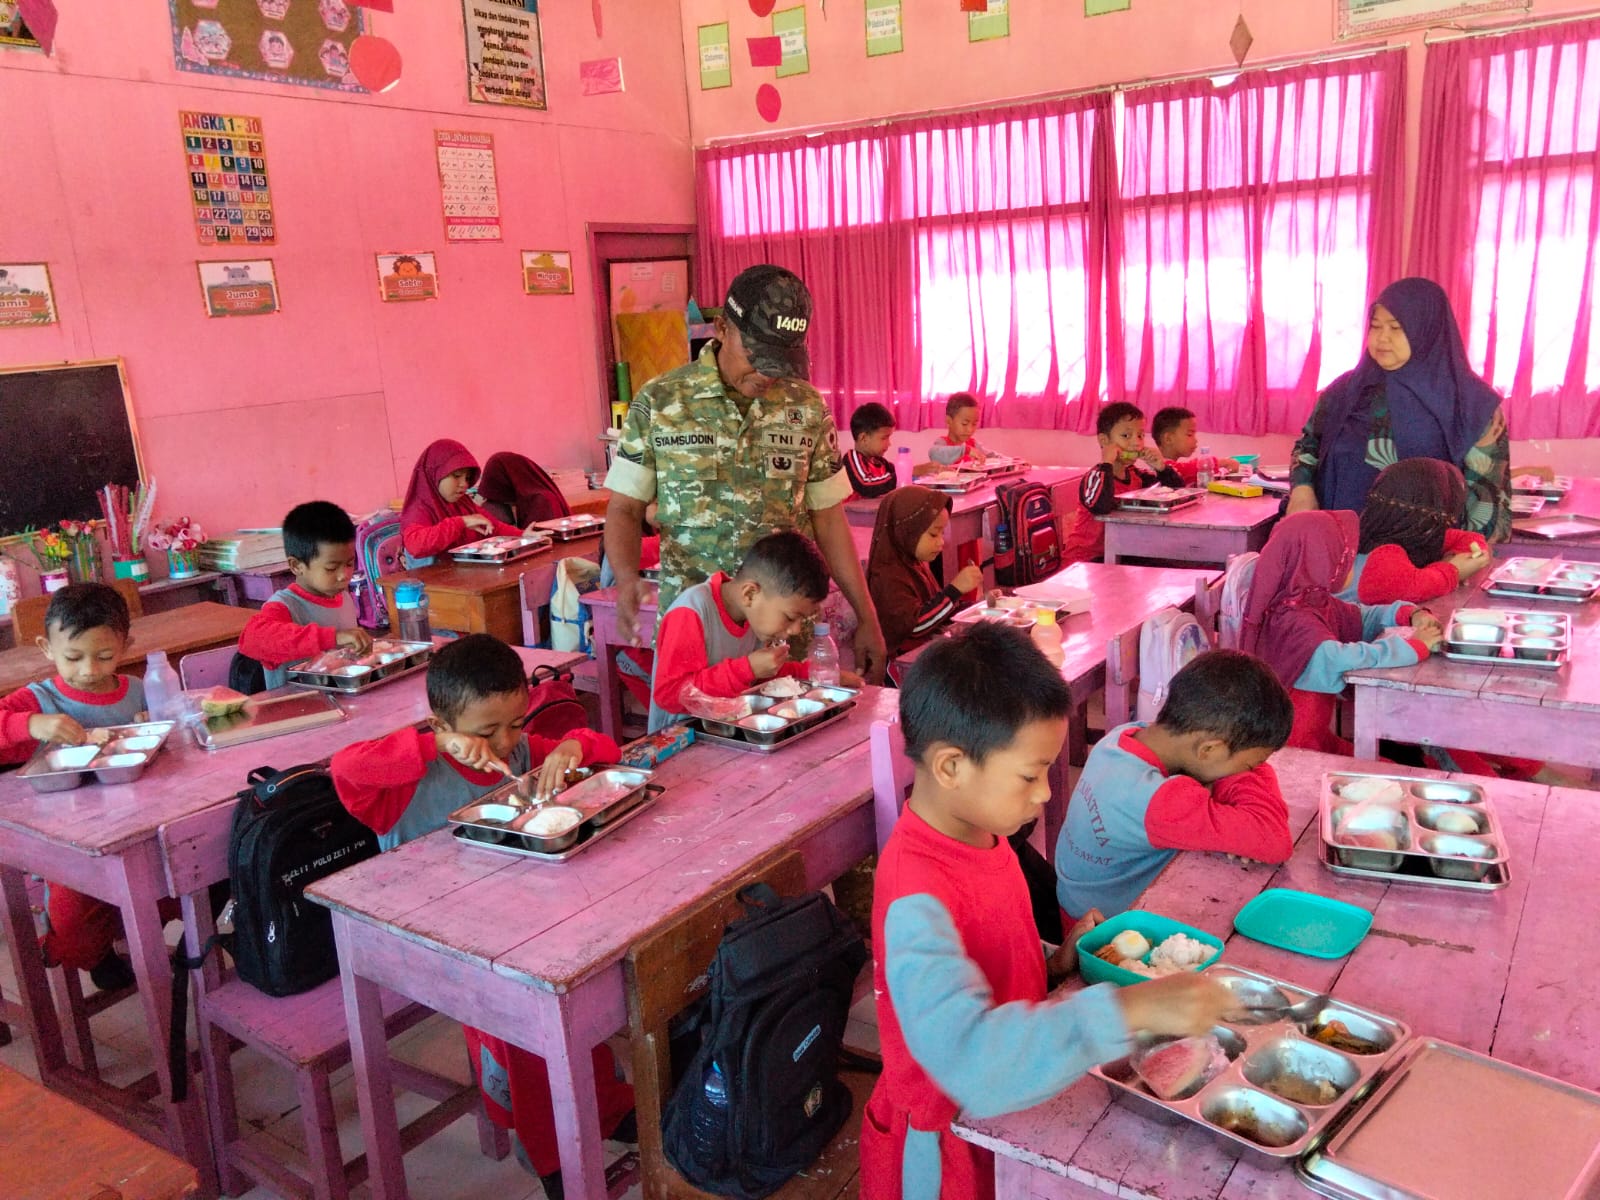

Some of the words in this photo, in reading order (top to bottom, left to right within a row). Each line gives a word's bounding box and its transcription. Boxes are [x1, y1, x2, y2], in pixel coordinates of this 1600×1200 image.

[488, 11, 497, 20] dan
[498, 12, 518, 24] tindakan
[519, 18, 530, 28] yang
[183, 113, 226, 131] ANGKA
[228, 118, 235, 132] 1
[245, 119, 260, 133] 30
[190, 137, 196, 147] 1
[205, 138, 212, 148] 2
[222, 139, 229, 149] 3
[252, 141, 259, 151] 5
[192, 155, 199, 164] 6
[224, 156, 231, 166] 8
[240, 158, 247, 168] 9
[253, 159, 263, 169] 10
[194, 173, 204, 183] 11
[209, 174, 219, 183] 12
[226, 175, 235, 184] 13
[241, 175, 251, 185] 14
[255, 176, 265, 186] 15
[196, 191, 207, 200] 16
[212, 191, 221, 200] 17
[228, 192, 239, 201] 18
[243, 192, 253, 201] 19
[257, 193, 268, 202] 20
[199, 209, 210, 218] 21
[214, 210, 226, 219] 22
[229, 210, 241, 219] 23
[245, 210, 256, 219] 24
[259, 210, 271, 220] 25
[201, 226, 213, 236] 26
[216, 227, 228, 236] 27
[232, 227, 244, 236] 28
[246, 227, 259, 236] 29
[261, 227, 273, 236] 30
[399, 279, 423, 287] Sabtu
[226, 289, 259, 299] Jumat
[0, 297, 29, 308] amis
[776, 315, 807, 332] 1409
[655, 434, 714, 447] SYAMSUDDIN
[768, 433, 793, 445] TNI
[800, 436, 813, 448] AD
